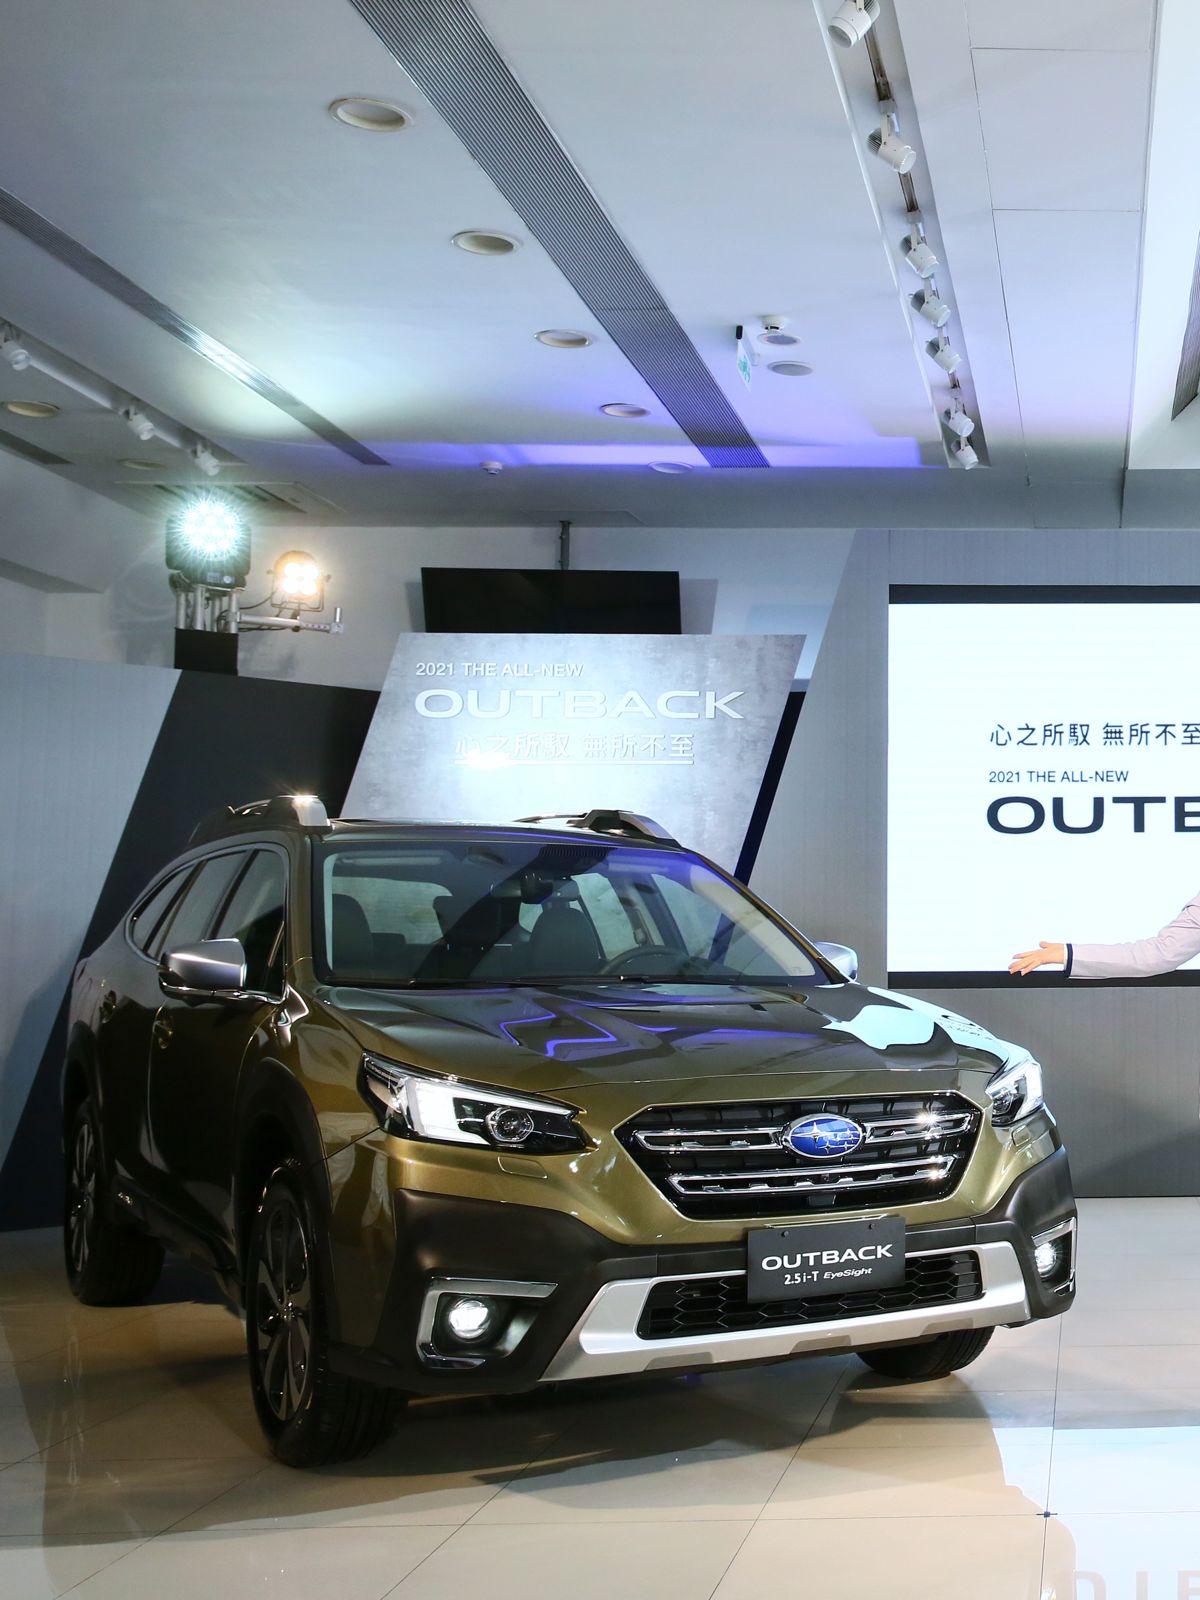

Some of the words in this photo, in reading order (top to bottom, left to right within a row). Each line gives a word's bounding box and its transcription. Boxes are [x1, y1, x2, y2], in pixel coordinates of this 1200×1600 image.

[416, 663, 453, 676] 2021
[461, 663, 497, 676] THE
[501, 663, 584, 677] ALL-NEW
[414, 688, 746, 719] OUTBACK
[584, 733, 694, 758] 無所不至
[990, 722, 1090, 746] 心之所馭
[989, 771, 1020, 783] 2021
[1027, 771, 1056, 783] THE
[1060, 771, 1129, 783] ALL-NEW
[761, 1244, 893, 1271] OUTBACK
[823, 1267, 873, 1280] EyeSight
